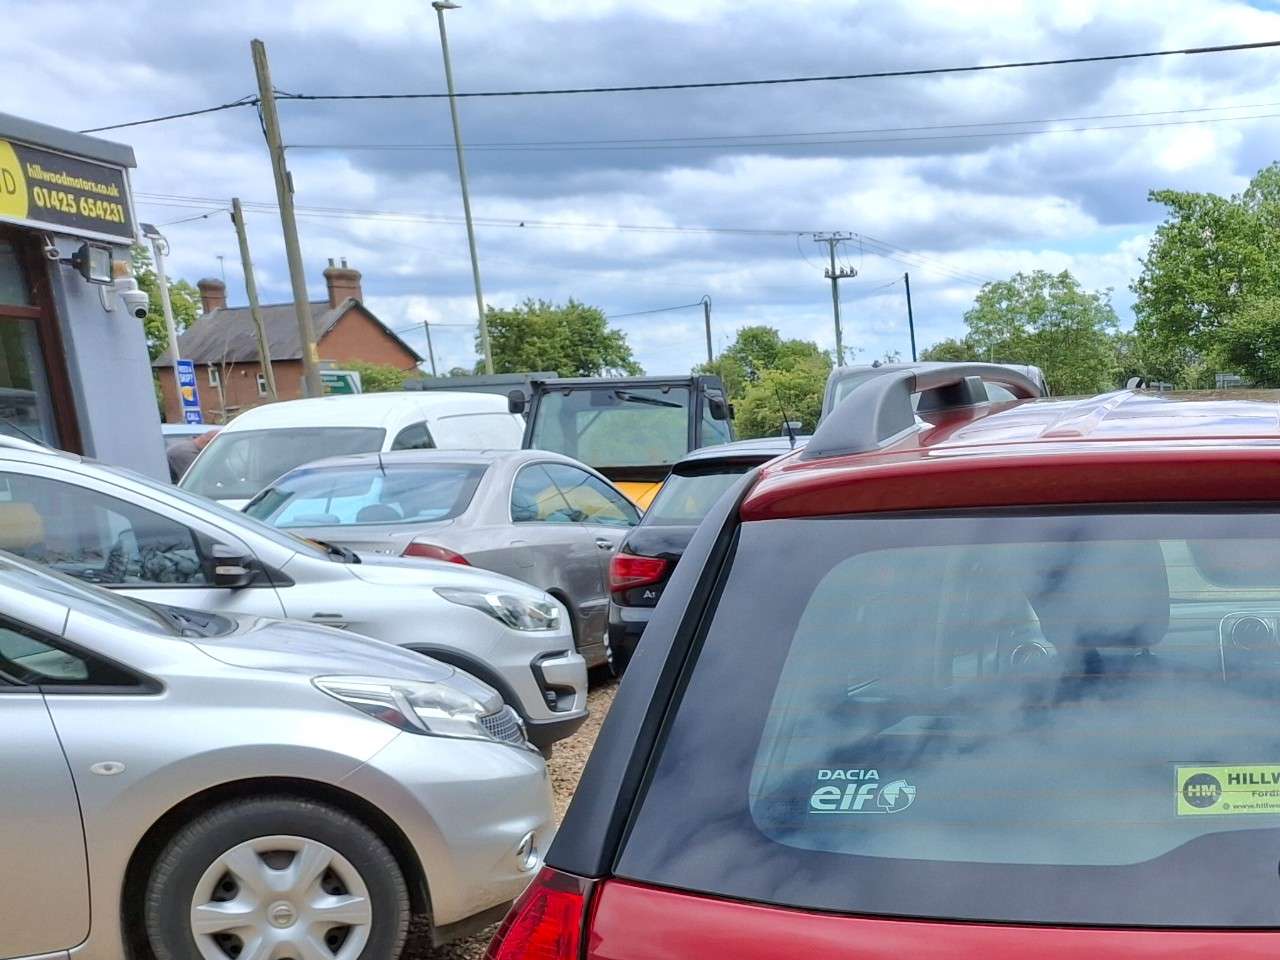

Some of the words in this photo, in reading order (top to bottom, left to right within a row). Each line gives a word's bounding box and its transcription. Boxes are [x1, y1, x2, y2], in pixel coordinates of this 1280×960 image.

[0, 168, 16, 195] D
[26, 162, 120, 197] hillwoodmotors.co.uk
[33, 187, 77, 214] 01425
[80, 197, 125, 224] 654231
[818, 769, 880, 780] DACIA
[810, 783, 879, 810] elf
[1188, 784, 1217, 797] HM
